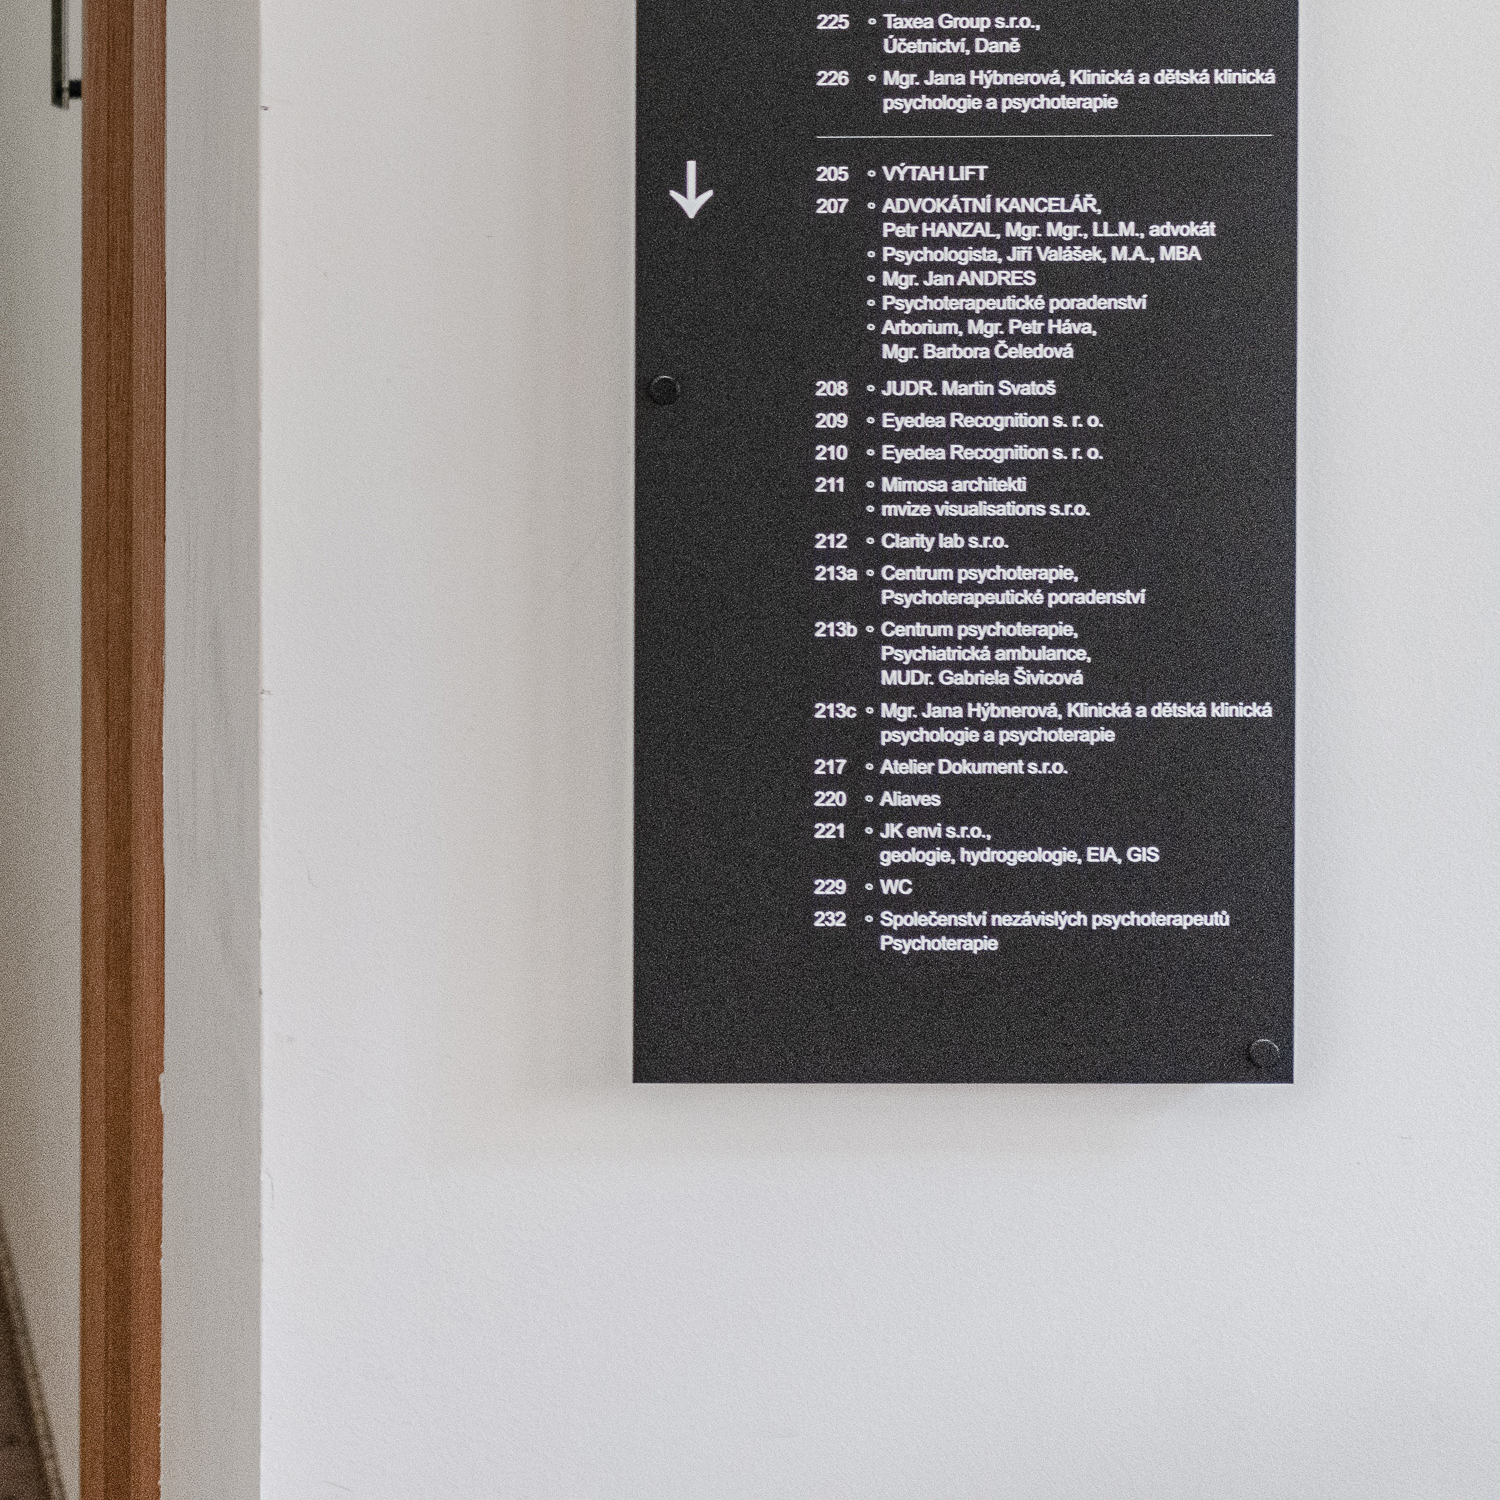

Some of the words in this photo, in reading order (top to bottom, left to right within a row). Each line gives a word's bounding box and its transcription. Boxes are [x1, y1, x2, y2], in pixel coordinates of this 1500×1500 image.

[816, 13, 851, 31] 225
[882, 13, 935, 30] Taxea
[937, 12, 992, 33] Group
[993, 16, 1041, 32] s.r.o.,
[882, 34, 971, 56] Účetnictví,
[974, 36, 1022, 54] Daně
[815, 69, 850, 87] 226
[882, 69, 921, 90] Mgr.
[923, 69, 967, 86] Jana
[969, 68, 1066, 90] Hýbnerová,
[1069, 68, 1136, 86] Klinická
[1137, 71, 1151, 85] a
[1152, 68, 1211, 85] dětská
[1213, 67, 1277, 85] klinická
[882, 93, 983, 115] psychologie
[984, 96, 998, 110] a
[1000, 93, 1119, 114] psychoterapie
[815, 165, 850, 182] 205
[881, 162, 945, 182] VÝTAH
[948, 164, 989, 182] LIFT
[815, 197, 850, 214] 207
[881, 193, 992, 214] ADVOKÁTNÍ
[994, 193, 1103, 216] KANCELÁŘ,
[882, 221, 920, 238] Petr
[921, 221, 1002, 240] HANZAL,
[1004, 221, 1043, 242] Mgr.
[1045, 221, 1089, 242] Mgr.,
[1091, 220, 1146, 240] LL.M.,
[1148, 220, 1217, 238] advokát
[882, 245, 1003, 267] Psychologista,
[1005, 245, 1034, 262] Jiří
[1035, 245, 1108, 264] Valášek,
[1110, 245, 1156, 264] M.A.,
[1159, 244, 1203, 262] MBA
[882, 270, 920, 291] Mgr.
[922, 270, 955, 287] Jan
[956, 269, 1037, 287] ANDRES
[881, 294, 1046, 315] Psychoterapeutické
[1048, 293, 1149, 314] poradenství
[880, 318, 964, 337] Arborium,
[967, 318, 1005, 339] Mgr.
[1008, 318, 1046, 335] Petr
[1047, 318, 1098, 337] Háva,
[881, 343, 919, 364] Mgr.
[922, 342, 993, 360] Barbora
[993, 339, 1075, 360] Čeledová
[814, 380, 849, 397] 208
[880, 379, 938, 397] JUDR.
[941, 379, 995, 397] Martin
[997, 379, 1057, 397] Svatoš
[814, 412, 849, 429] 209
[881, 411, 947, 433] Eyedea
[949, 411, 1050, 432] Recognition
[1052, 414, 1068, 428] s.
[1071, 414, 1084, 428] r.
[1086, 414, 1104, 428] o.
[814, 476, 845, 493] 211
[881, 476, 949, 493] Mimosa
[950, 476, 1027, 493] architekti
[880, 500, 932, 517] mvize
[933, 500, 1047, 517] visualisations
[1048, 503, 1091, 517] s.r.o.
[814, 532, 848, 550] 212
[880, 532, 936, 553] Clarity
[938, 532, 966, 549] lab
[967, 535, 1010, 549] s.r.o.
[814, 620, 858, 638] 213b
[880, 620, 954, 638] Centrum
[956, 620, 1079, 641] psychoterapie,
[880, 644, 992, 666] Psychiatrická
[994, 644, 1092, 664] ambulance,
[880, 669, 935, 686] MUDr.
[937, 668, 1010, 686] Gabriela
[1012, 665, 1084, 686] Šivicová
[813, 702, 858, 719] 213c
[880, 702, 918, 723] Mgr.
[920, 702, 964, 719] Jana
[967, 701, 1063, 723] Hýbnerová,
[1066, 701, 1133, 719] Klinická
[1134, 704, 1148, 719] a
[1150, 701, 1208, 719] dětská
[1210, 701, 1274, 719] klinická
[880, 726, 981, 747] psychologie
[982, 729, 996, 743] a
[998, 726, 1116, 747] psychoterapie
[813, 758, 848, 775] 217
[879, 758, 936, 775] Atelier
[937, 758, 1025, 775] Dokument
[1026, 761, 1069, 775] s.r.o.
[813, 790, 848, 807] 220
[879, 790, 942, 807] Aliaves
[813, 822, 845, 839] 221
[879, 822, 904, 839] JK
[905, 822, 943, 839] envi
[945, 825, 992, 841] s.r.o.,
[879, 846, 956, 867] geologie,
[959, 846, 1083, 867] hydrogeologie,
[1086, 846, 1123, 865] EIA,
[1125, 845, 1161, 863] GIS
[813, 878, 847, 896] 229
[879, 878, 913, 896] WC
[813, 910, 847, 928] 232
[879, 910, 988, 931] Společenství
[990, 910, 1088, 931] nezávislých
[1091, 909, 1231, 931] psychoterapeutů
[879, 934, 1000, 955] Psychoterapie
